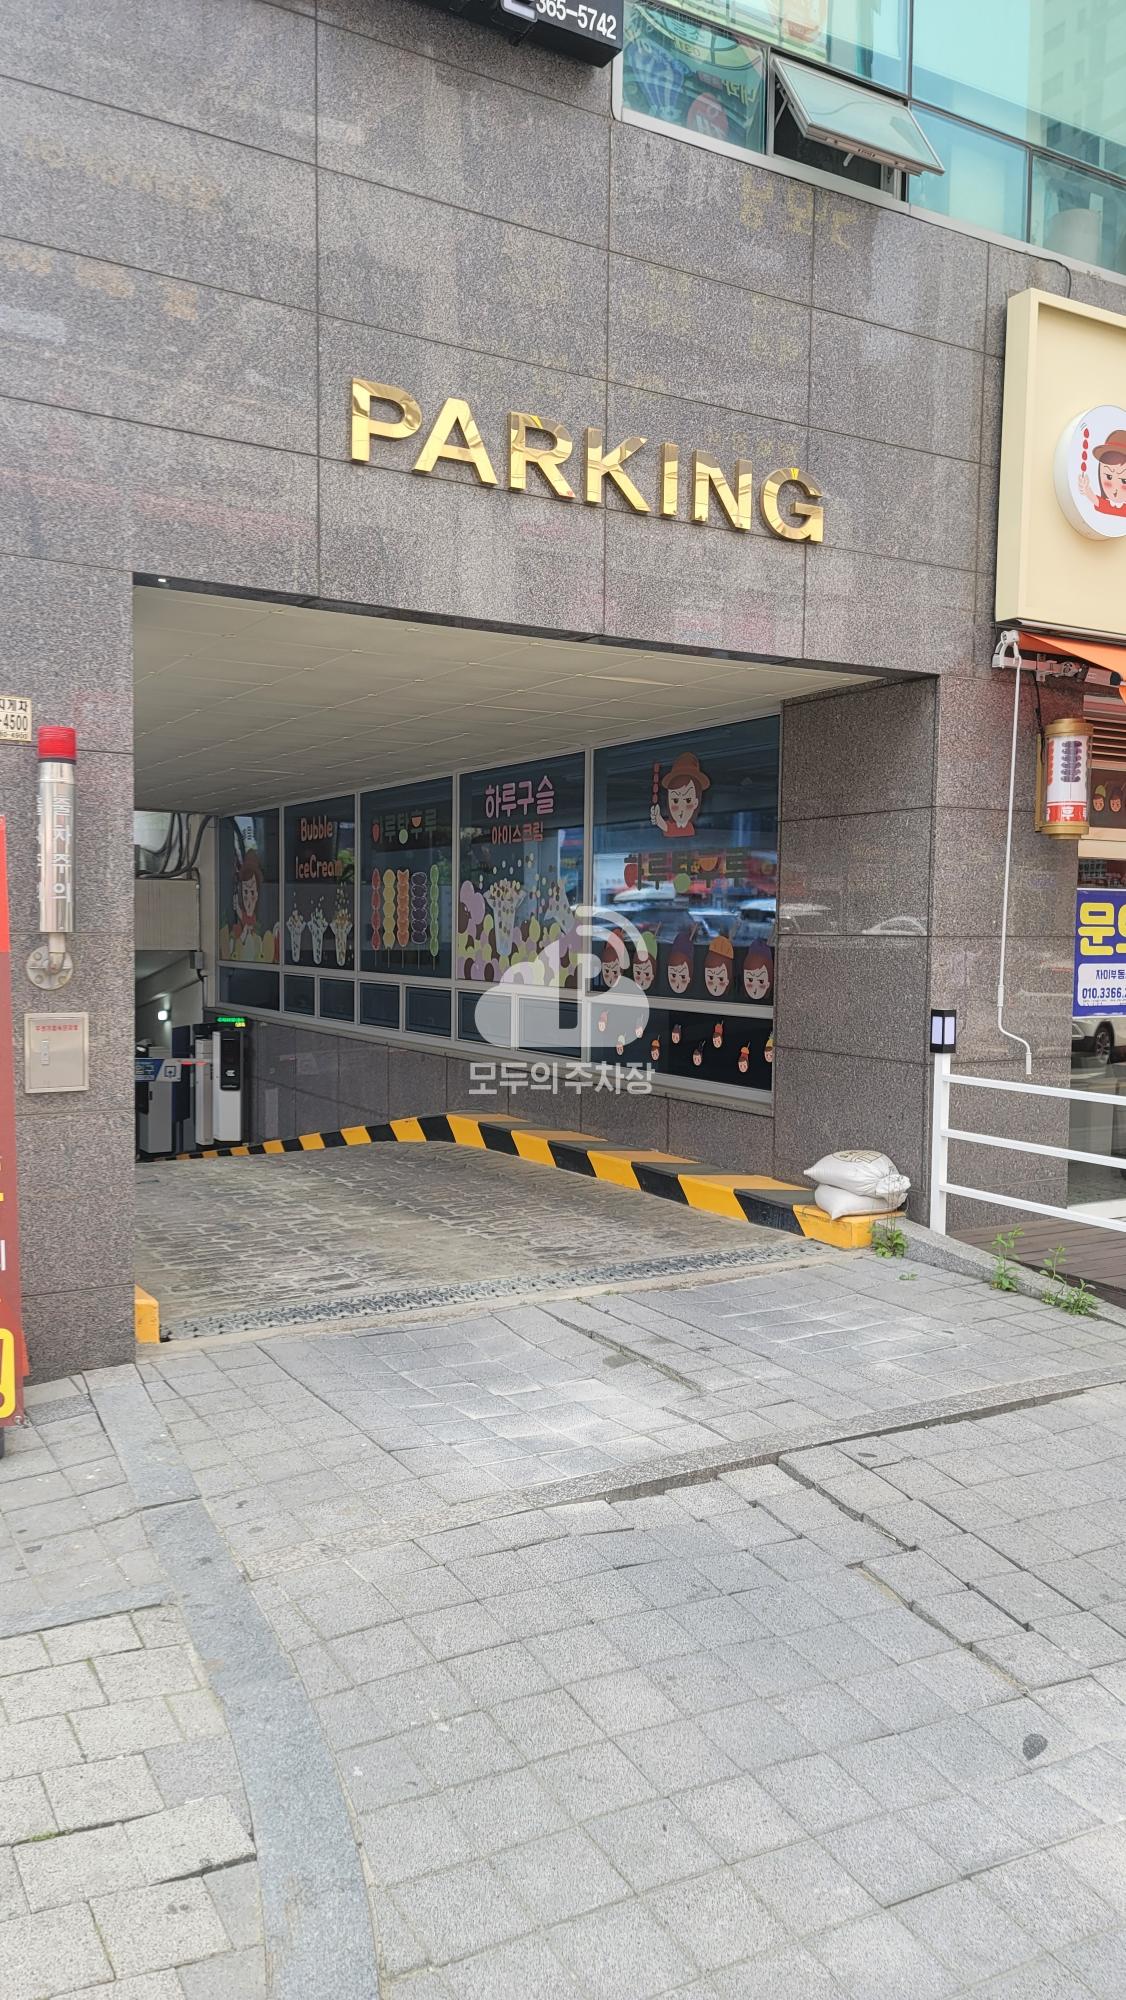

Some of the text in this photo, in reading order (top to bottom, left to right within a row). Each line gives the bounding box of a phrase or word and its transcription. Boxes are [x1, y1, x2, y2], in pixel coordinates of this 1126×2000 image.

[351, 377, 825, 544] PARKING
[485, 775, 555, 819] 하루구슬
[300, 816, 333, 841] Bubble
[491, 821, 544, 845] 아이스크림
[53, 793, 72, 902] 출차주의
[295, 854, 344, 879] IceCream
[1095, 968, 1126, 980] 자이부동
